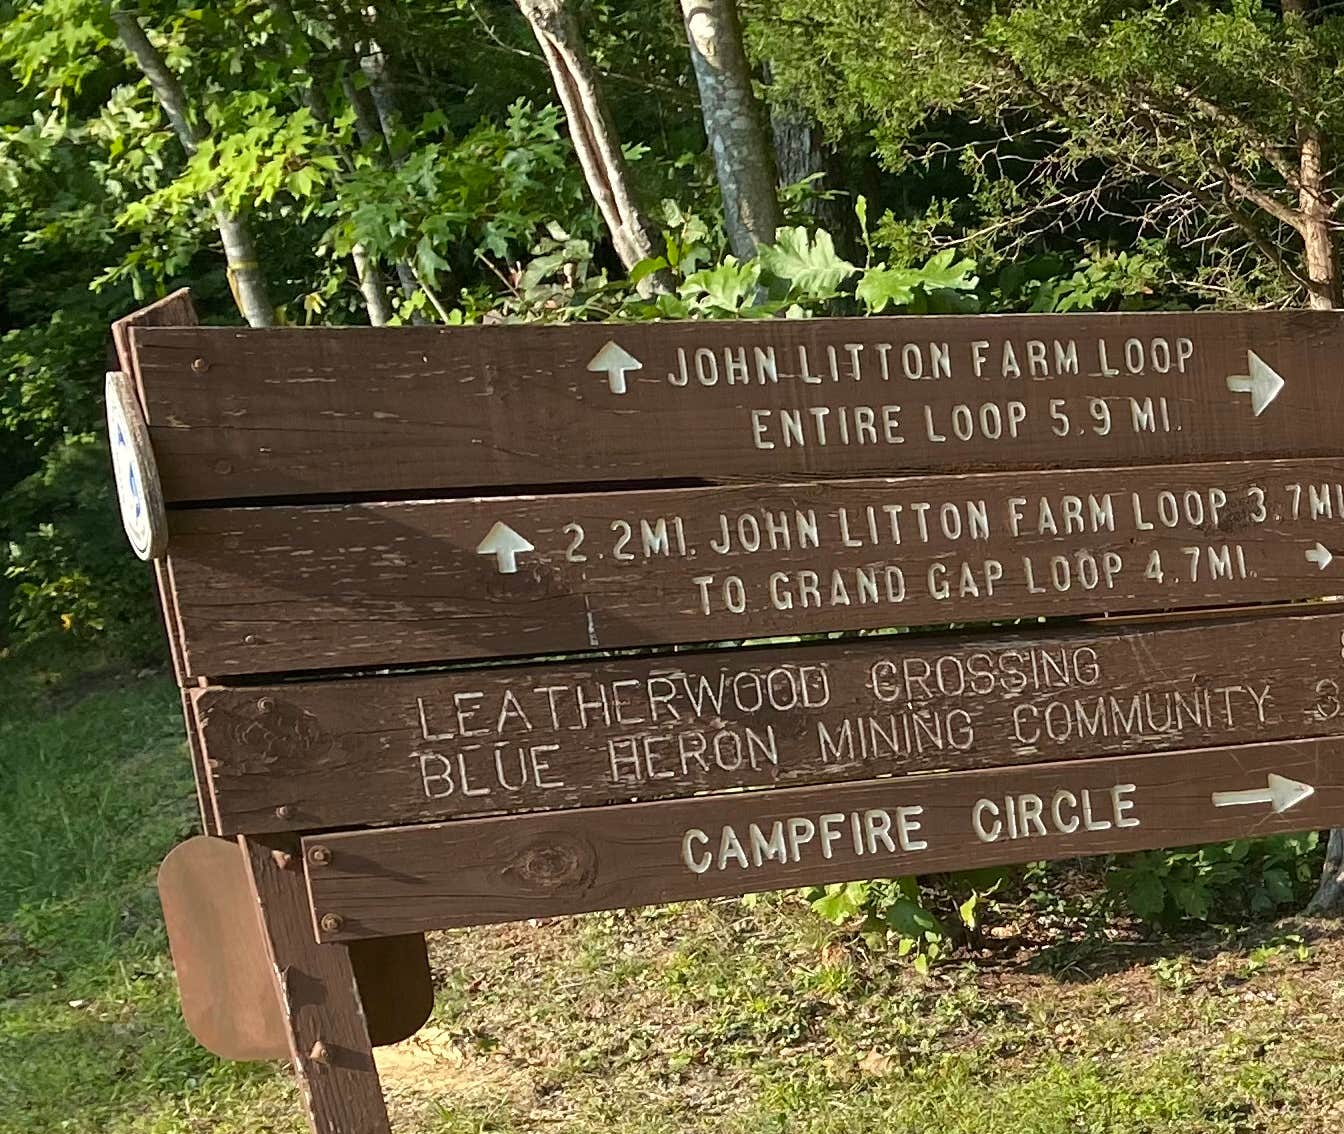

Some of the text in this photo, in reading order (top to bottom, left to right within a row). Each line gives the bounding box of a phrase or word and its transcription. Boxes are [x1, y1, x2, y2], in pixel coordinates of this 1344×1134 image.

[667, 337, 1194, 387] JOHN LITTON FARM LOOP
[750, 396, 1183, 450] ENTIRE LOOP 5.9 MI.
[709, 509, 821, 554] JOHN
[838, 500, 991, 548] LITTON
[1007, 493, 1116, 538] FARM
[1131, 487, 1227, 531] LOOP
[692, 575, 747, 616] TO
[768, 564, 906, 612] GRAND
[927, 560, 1003, 601] GAP
[1022, 551, 1123, 595] LOOP
[416, 662, 831, 742] LEATHERWOOD
[869, 645, 1100, 702] CROSSING
[418, 743, 565, 799] BLUE
[606, 724, 779, 783] HERON
[816, 707, 975, 763] MINING
[1011, 684, 1272, 745] COMMUNITY
[682, 783, 1141, 875] CAMPFIRE CIRCLE
